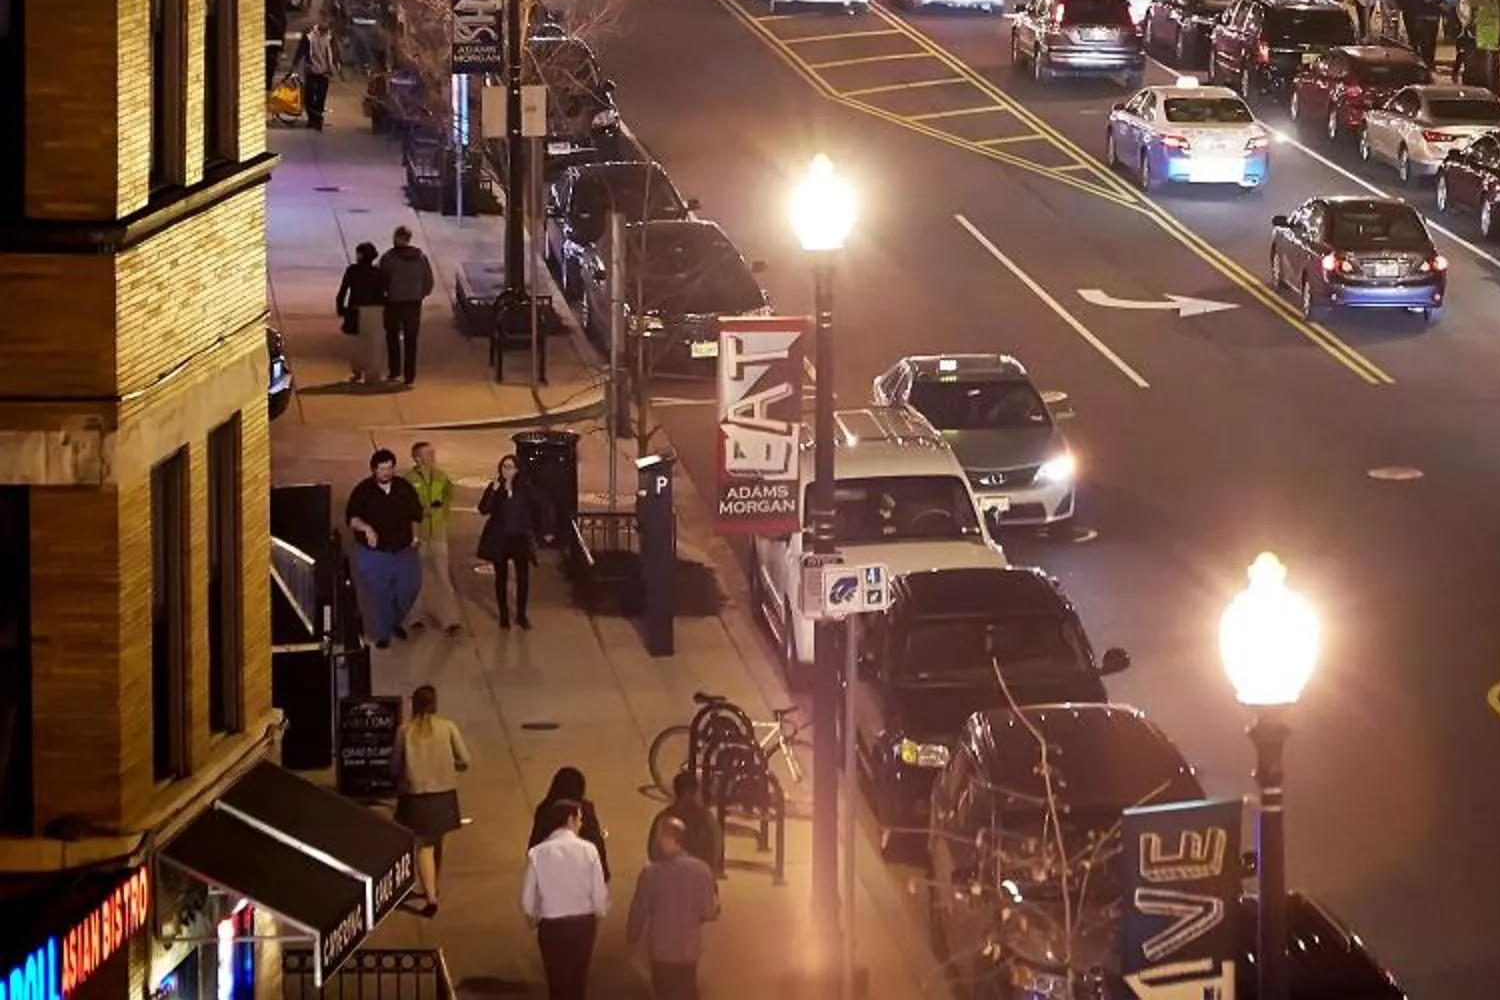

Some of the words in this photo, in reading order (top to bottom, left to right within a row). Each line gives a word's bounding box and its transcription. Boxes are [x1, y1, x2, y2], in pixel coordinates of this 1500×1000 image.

[725, 335, 798, 480] EAT
[656, 475, 669, 495] P
[727, 485, 789, 499] ADAMS
[719, 499, 796, 515] MORGAN
[61, 908, 101, 994] ASIAN
[101, 865, 148, 961] BISTRO
